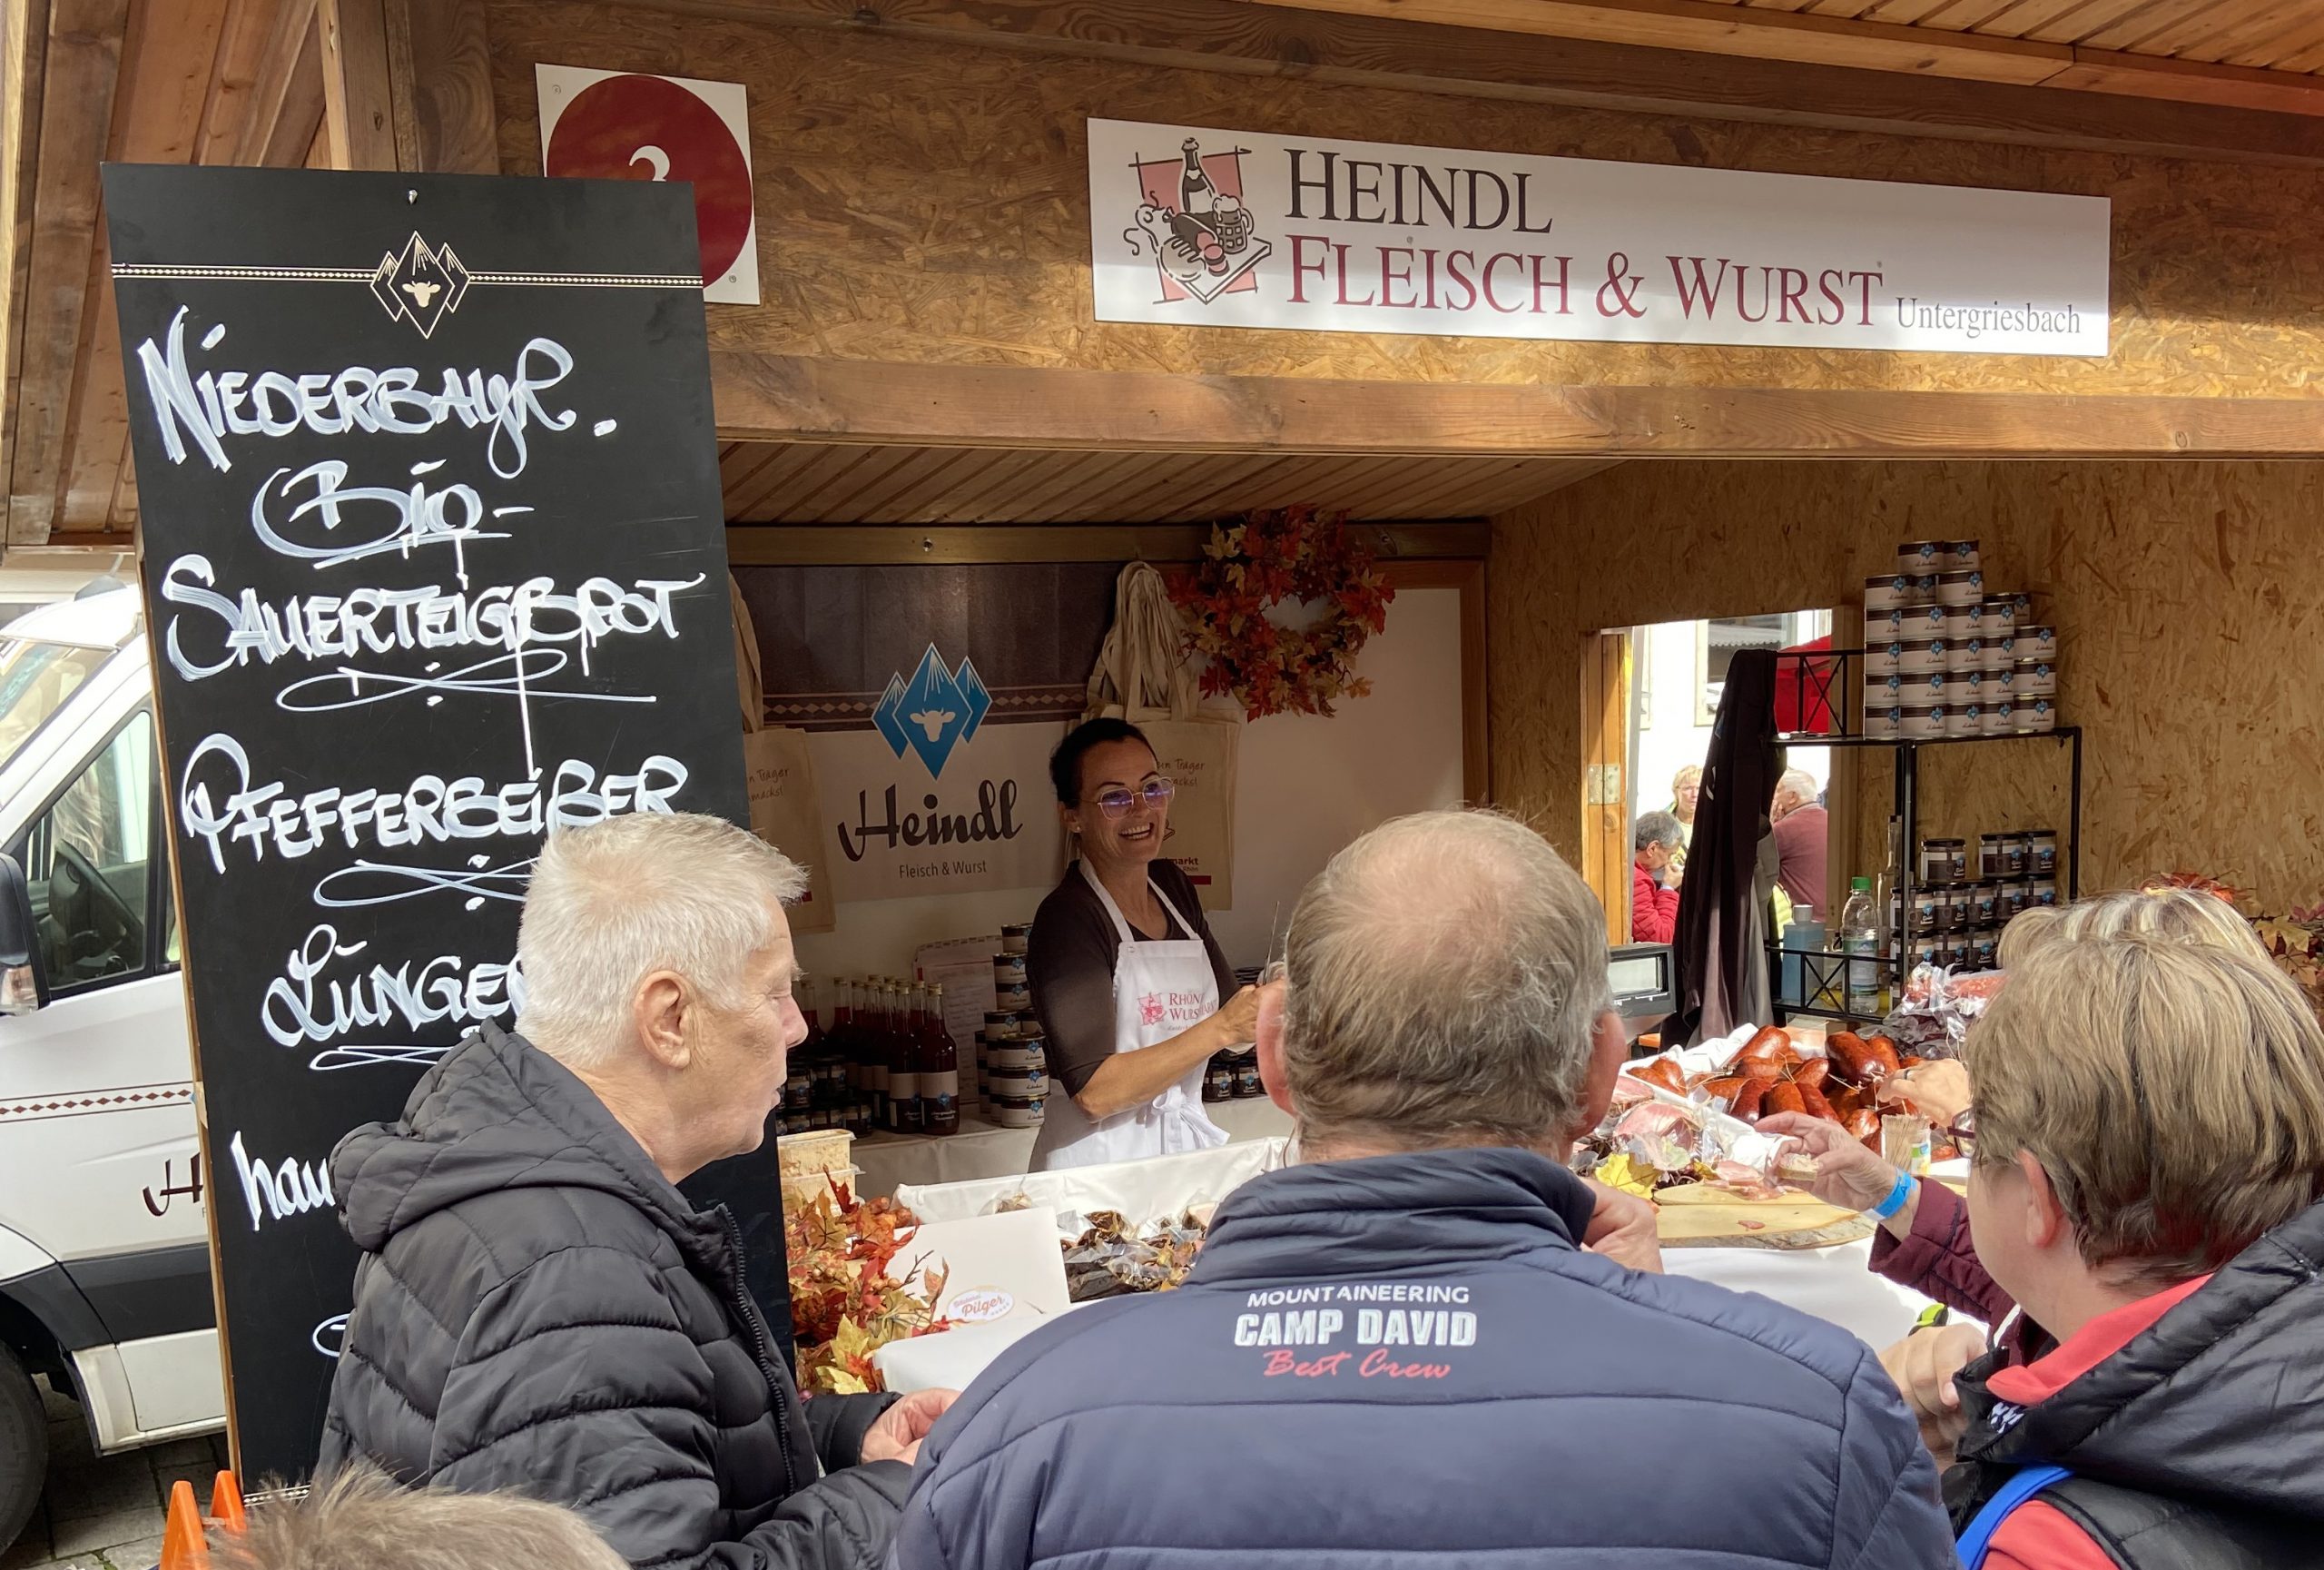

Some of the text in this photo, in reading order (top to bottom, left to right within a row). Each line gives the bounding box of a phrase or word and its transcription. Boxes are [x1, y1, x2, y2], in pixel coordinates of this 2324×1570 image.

[1283, 148, 1553, 234] HEINDL
[1285, 234, 2082, 339] FLEISCH & WURST Untergriesbach
[837, 779, 1023, 862] Heindl
[899, 860, 987, 879] Fleisch & Wurst
[961, 1296, 1003, 1317] Pilger
[1247, 1285, 1470, 1308] MOUNTAINEERING
[1234, 1308, 1477, 1347] CAMP DAVID
[1263, 1348, 1451, 1378] Best Crew
